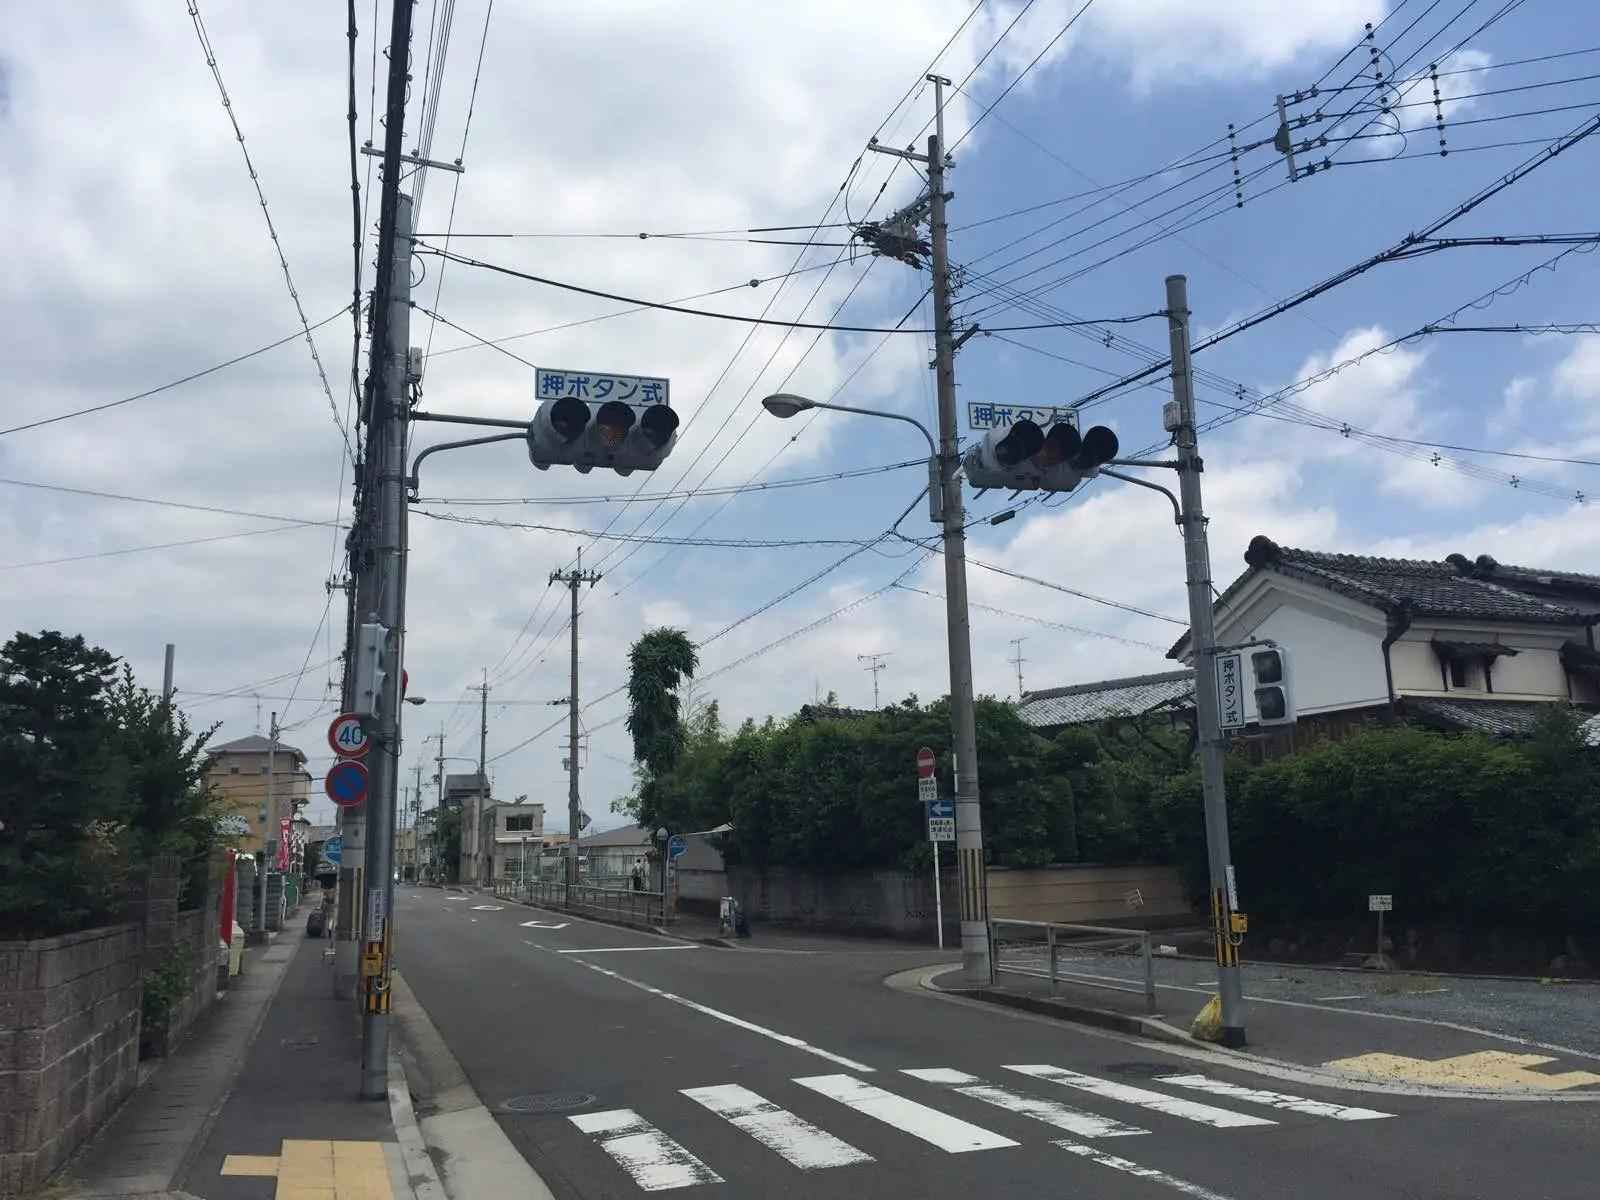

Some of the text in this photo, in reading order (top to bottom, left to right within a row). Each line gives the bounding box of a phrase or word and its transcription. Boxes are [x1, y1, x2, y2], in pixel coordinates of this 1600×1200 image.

[542, 373, 663, 403] 押ボタン式
[1223, 659, 1238, 723] 押ボタン式
[338, 725, 363, 745] 40
